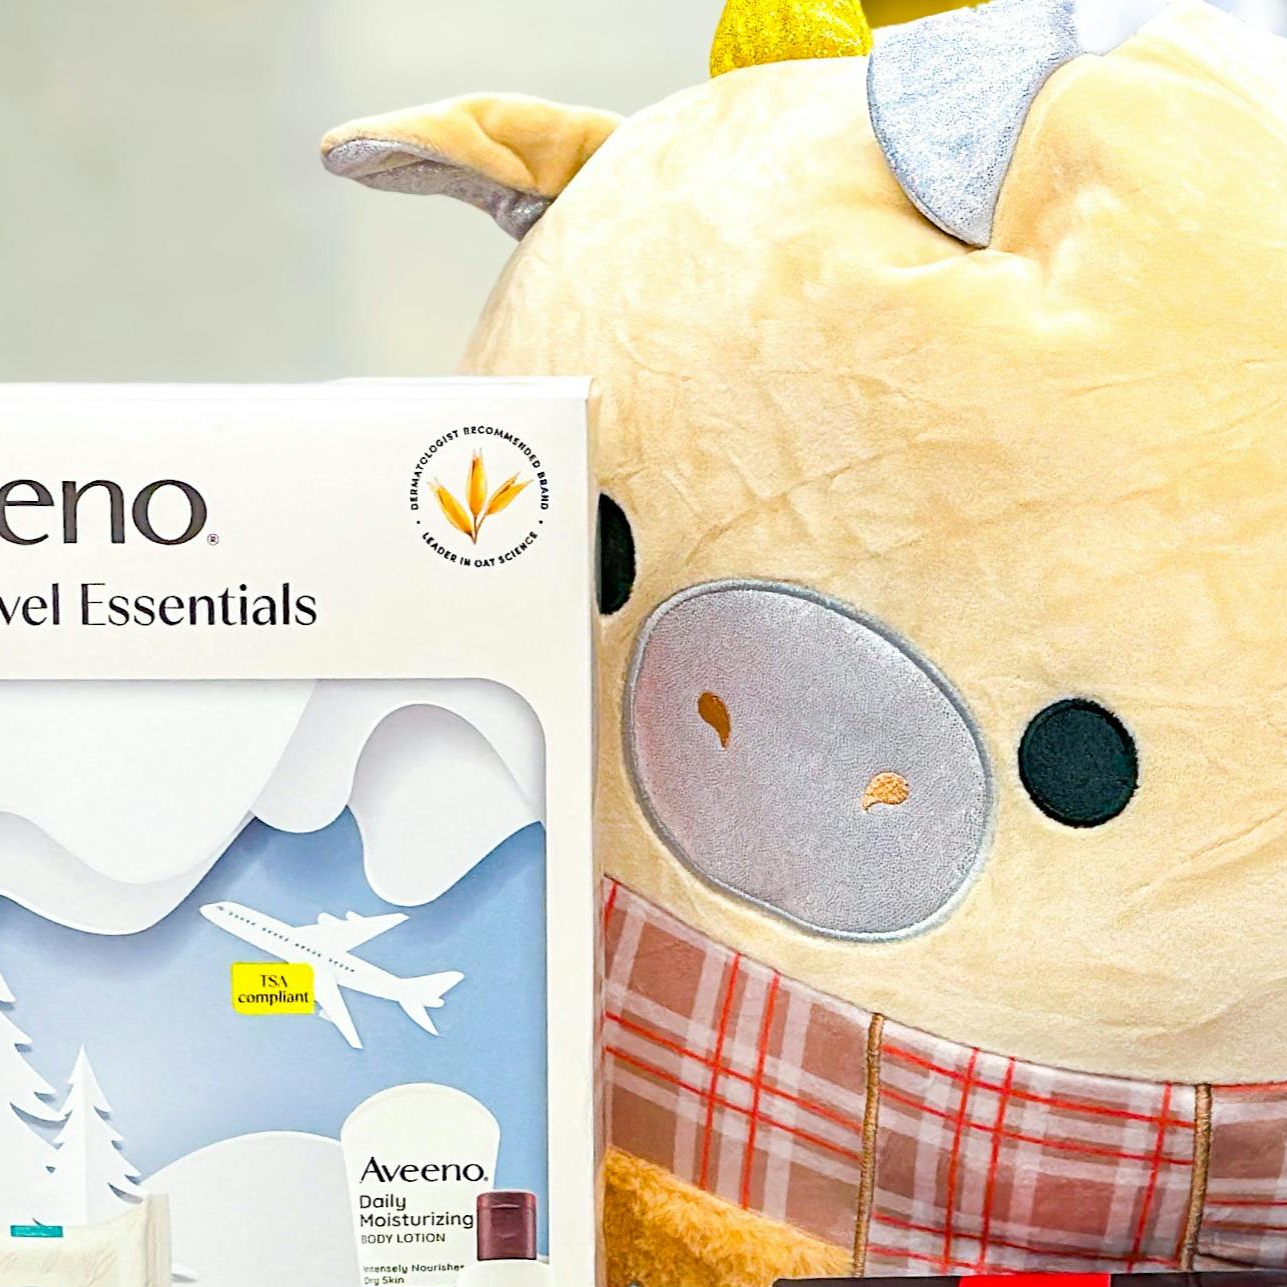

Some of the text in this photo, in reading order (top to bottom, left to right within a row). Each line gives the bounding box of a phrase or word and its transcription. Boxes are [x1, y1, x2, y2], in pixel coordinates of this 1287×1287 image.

[410, 425, 550, 511] DERMATOLOGIST RECOMMENDED BRAND
[422, 531, 538, 568] LEADER IN OAT SCIENCE
[80, 583, 318, 626] Essentials
[260, 974, 288, 988] TSA
[238, 990, 309, 1006] compliant
[359, 1194, 407, 1211] Daily
[360, 1211, 474, 1229] Moisturizing
[361, 1233, 446, 1245] BODY LOTION
[382, 1276, 405, 1285] Skin
